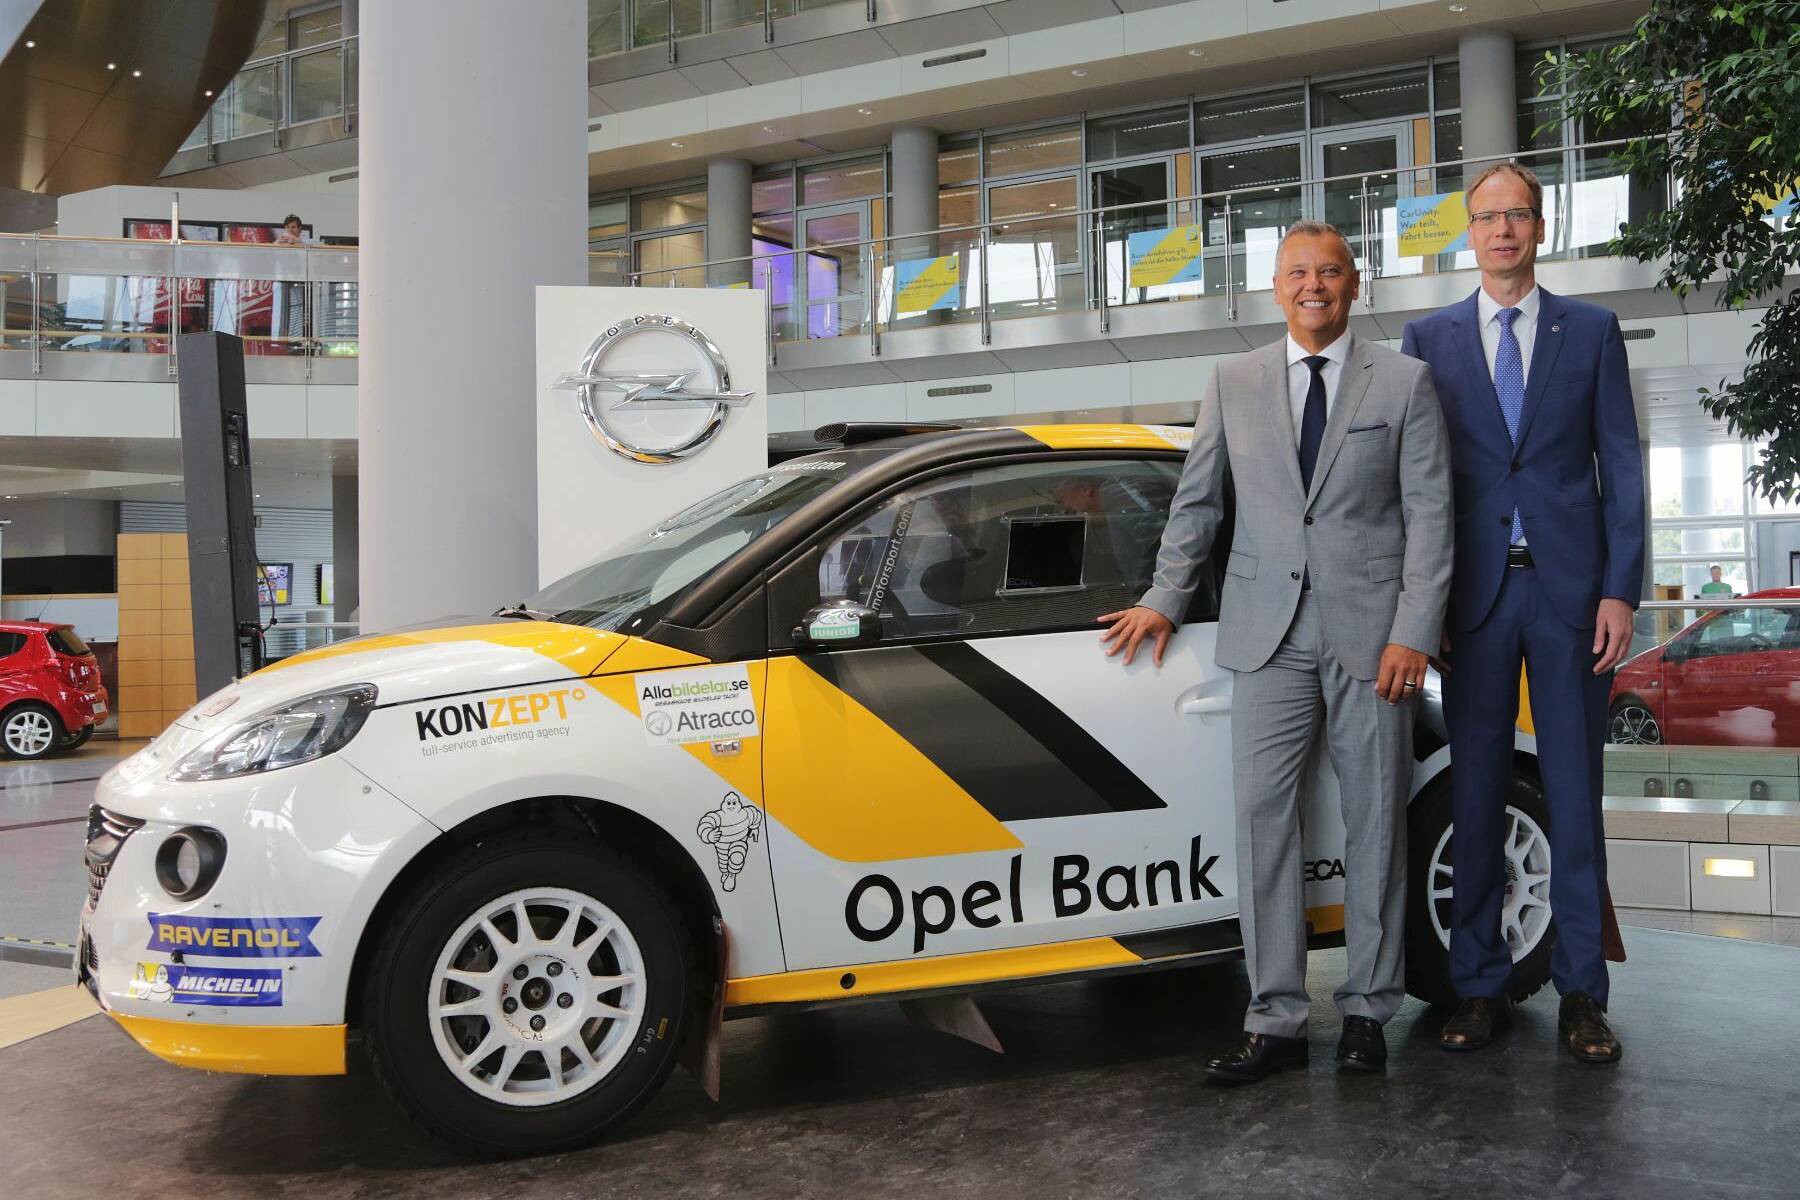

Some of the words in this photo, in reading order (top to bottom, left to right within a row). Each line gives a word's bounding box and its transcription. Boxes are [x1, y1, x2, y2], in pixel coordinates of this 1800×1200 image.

[1400, 221, 1417, 230] Wer
[606, 315, 698, 338] OPEL
[871, 510, 912, 612] motorsport.com
[814, 625, 857, 638] JUNIOR
[642, 679, 749, 701] Allabildelar.se
[677, 708, 756, 732] Atracco
[421, 738, 478, 758] full-service
[480, 729, 534, 747] advertising
[536, 725, 571, 742] agency
[844, 853, 1024, 954] Opel
[1051, 834, 1224, 919] Bank
[158, 923, 301, 948] RAVENOL
[177, 975, 281, 993] MICHELIN
